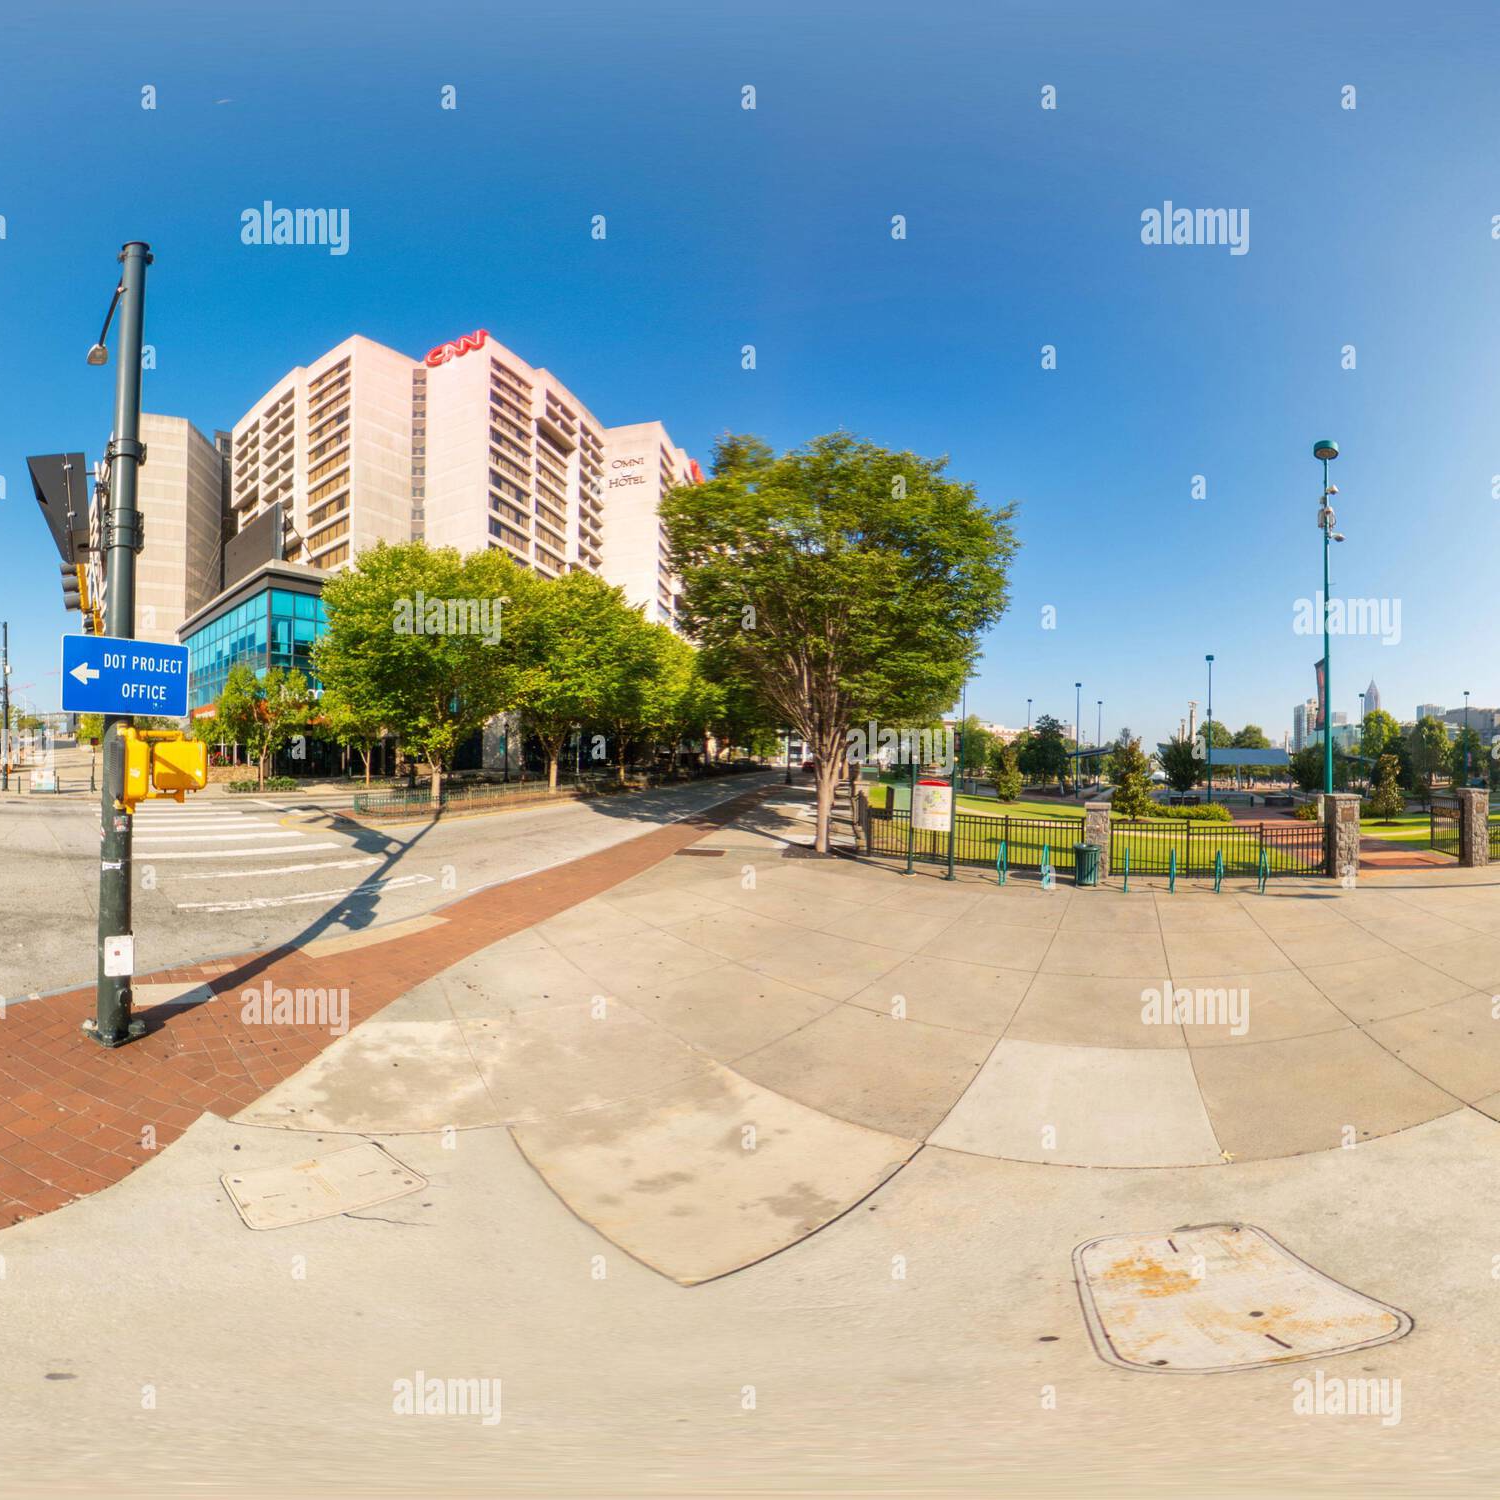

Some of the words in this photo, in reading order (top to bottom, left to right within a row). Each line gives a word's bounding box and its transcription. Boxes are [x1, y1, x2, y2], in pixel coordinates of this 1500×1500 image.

[425, 329, 490, 368] CNN
[611, 457, 644, 469] OMNI
[609, 476, 646, 489] HOTEL
[103, 653, 127, 670] DOT
[132, 655, 183, 675] PROJECT
[121, 682, 167, 701] OFFICE
